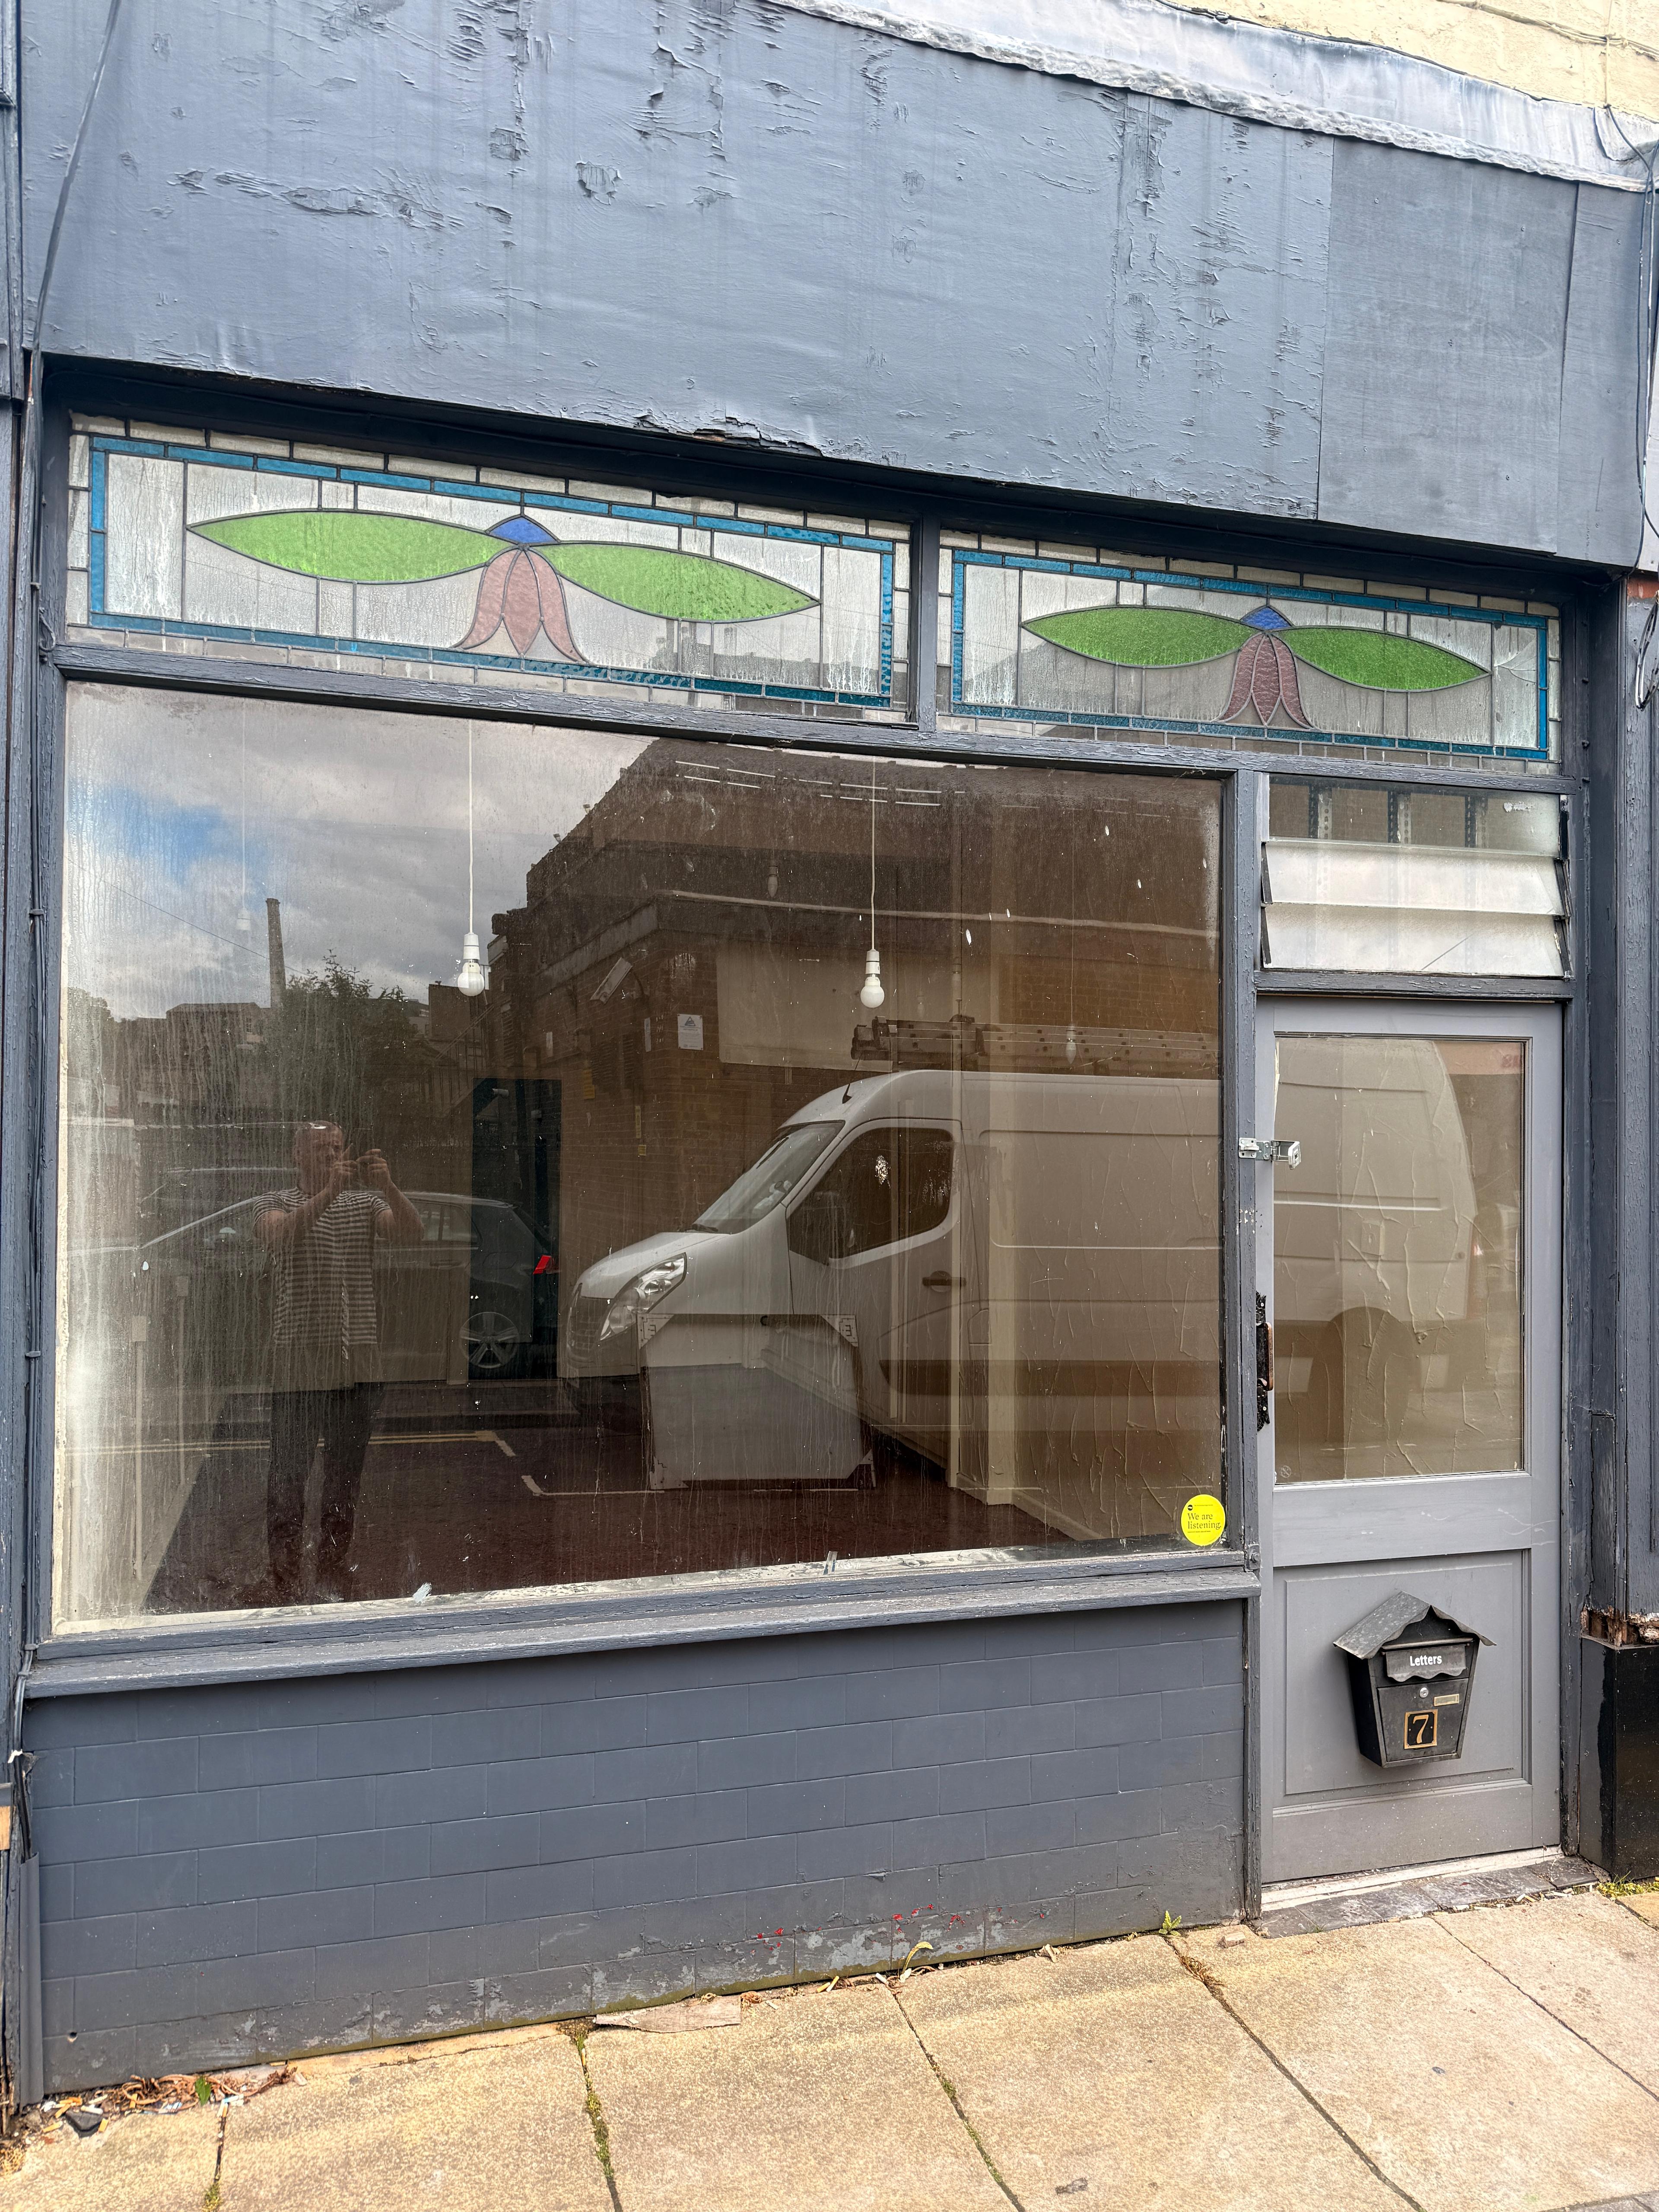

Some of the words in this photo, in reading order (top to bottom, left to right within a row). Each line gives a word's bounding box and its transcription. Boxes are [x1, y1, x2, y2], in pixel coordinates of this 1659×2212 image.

[1188, 1521, 1221, 1530] listening.
[1410, 1655, 1442, 1666] Letters
[1413, 1714, 1429, 1744] 7
